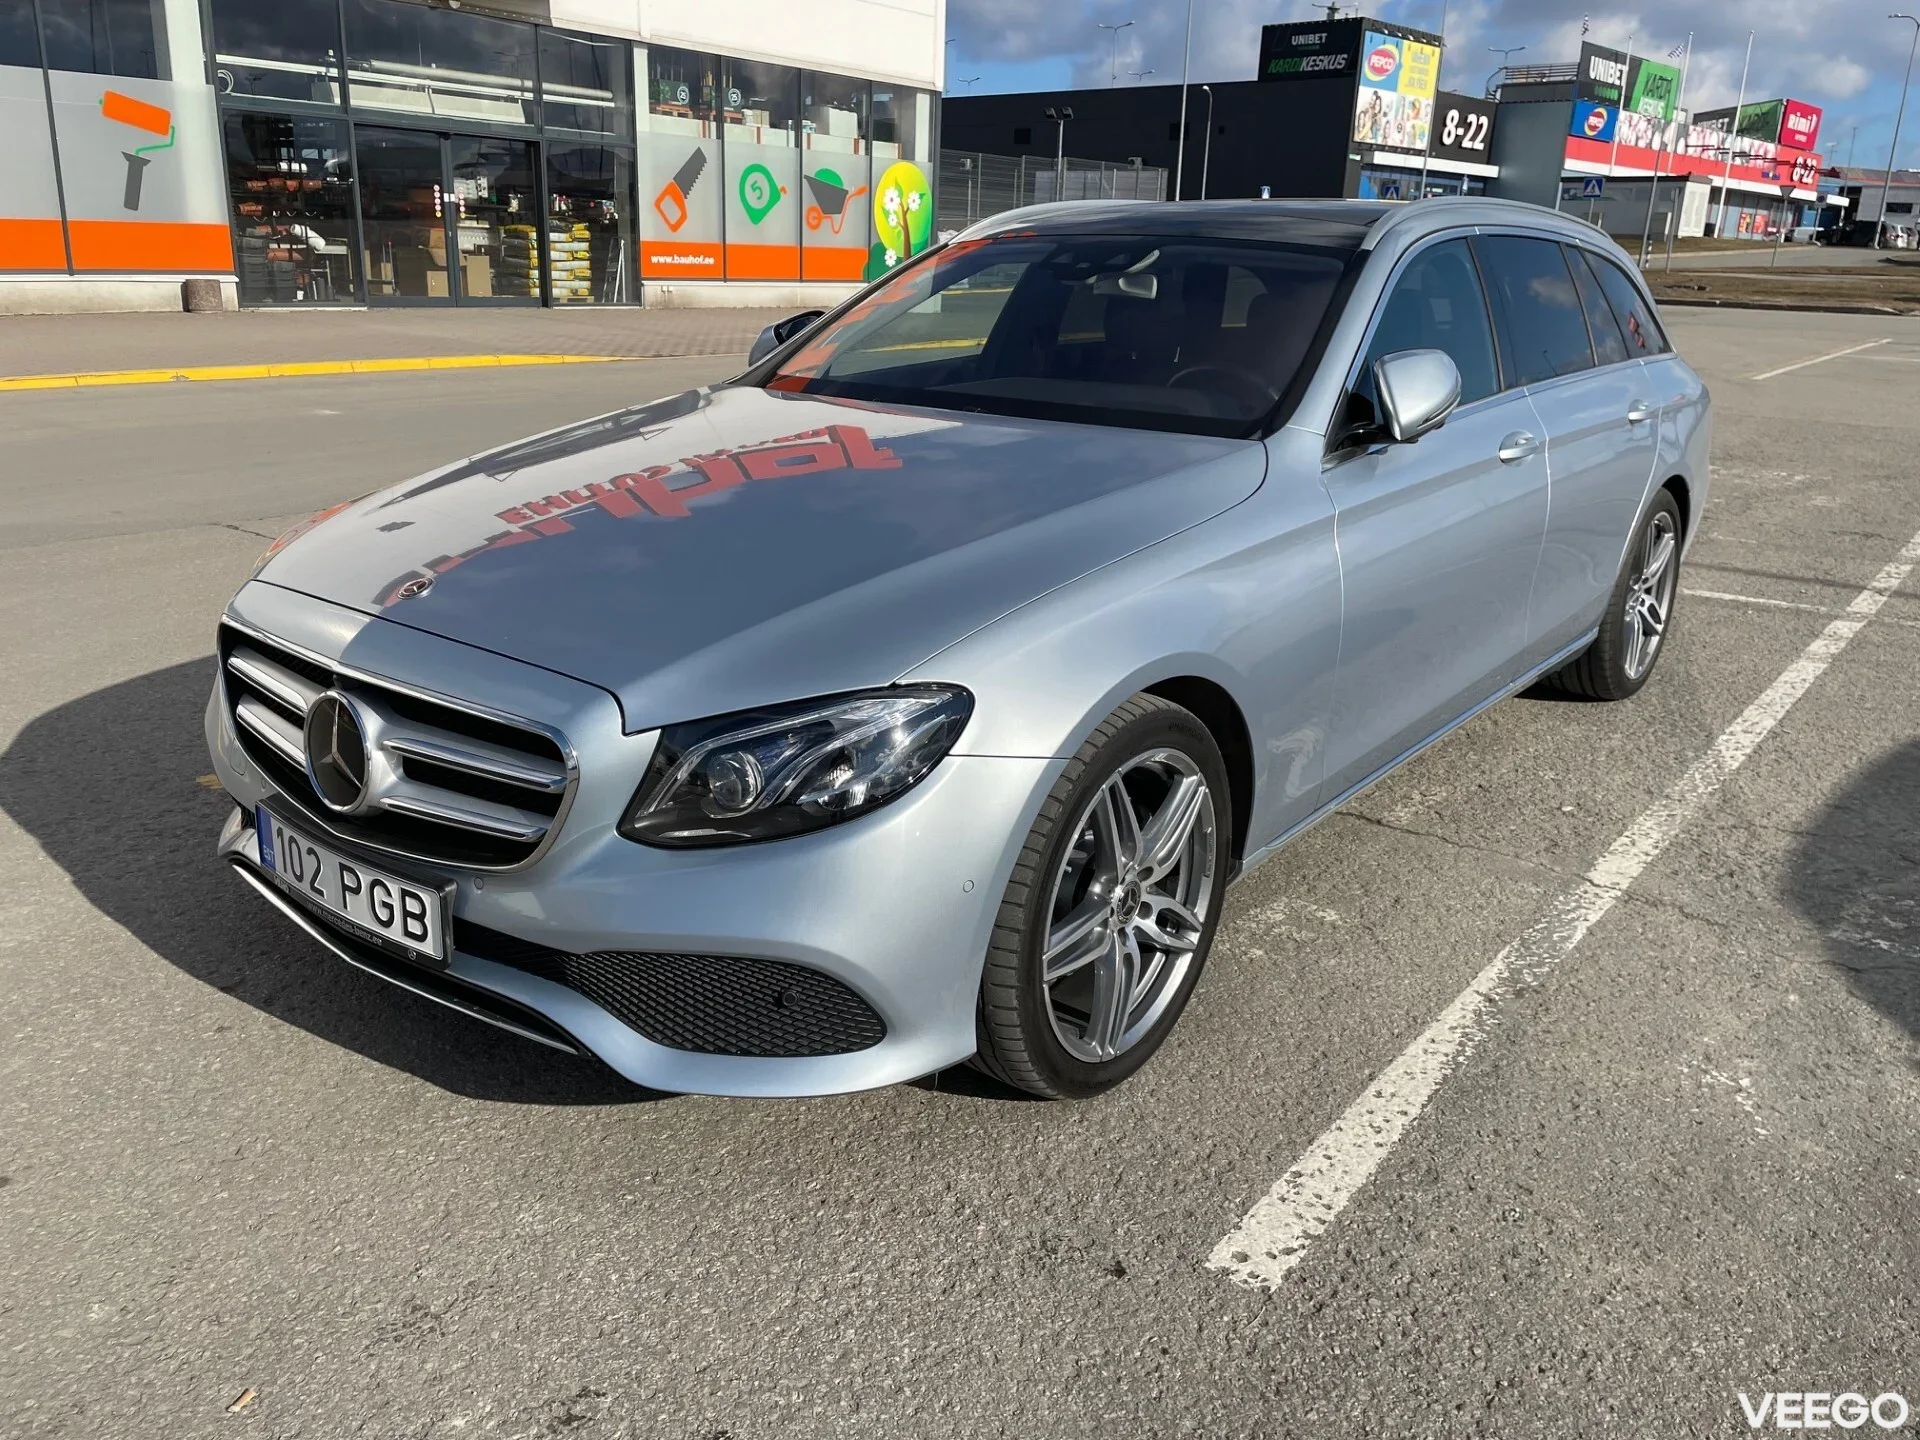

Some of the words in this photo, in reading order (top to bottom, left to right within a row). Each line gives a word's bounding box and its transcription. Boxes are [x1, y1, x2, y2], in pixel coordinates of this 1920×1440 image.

[1291, 33, 1328, 46] UNIBET
[1370, 55, 1394, 69] PEPCO
[1441, 109, 1489, 150] 8-22
[750, 180, 763, 201] 5
[651, 254, 715, 266] www.bauhof.ee
[276, 826, 326, 899] 102
[338, 861, 429, 943] PGB
